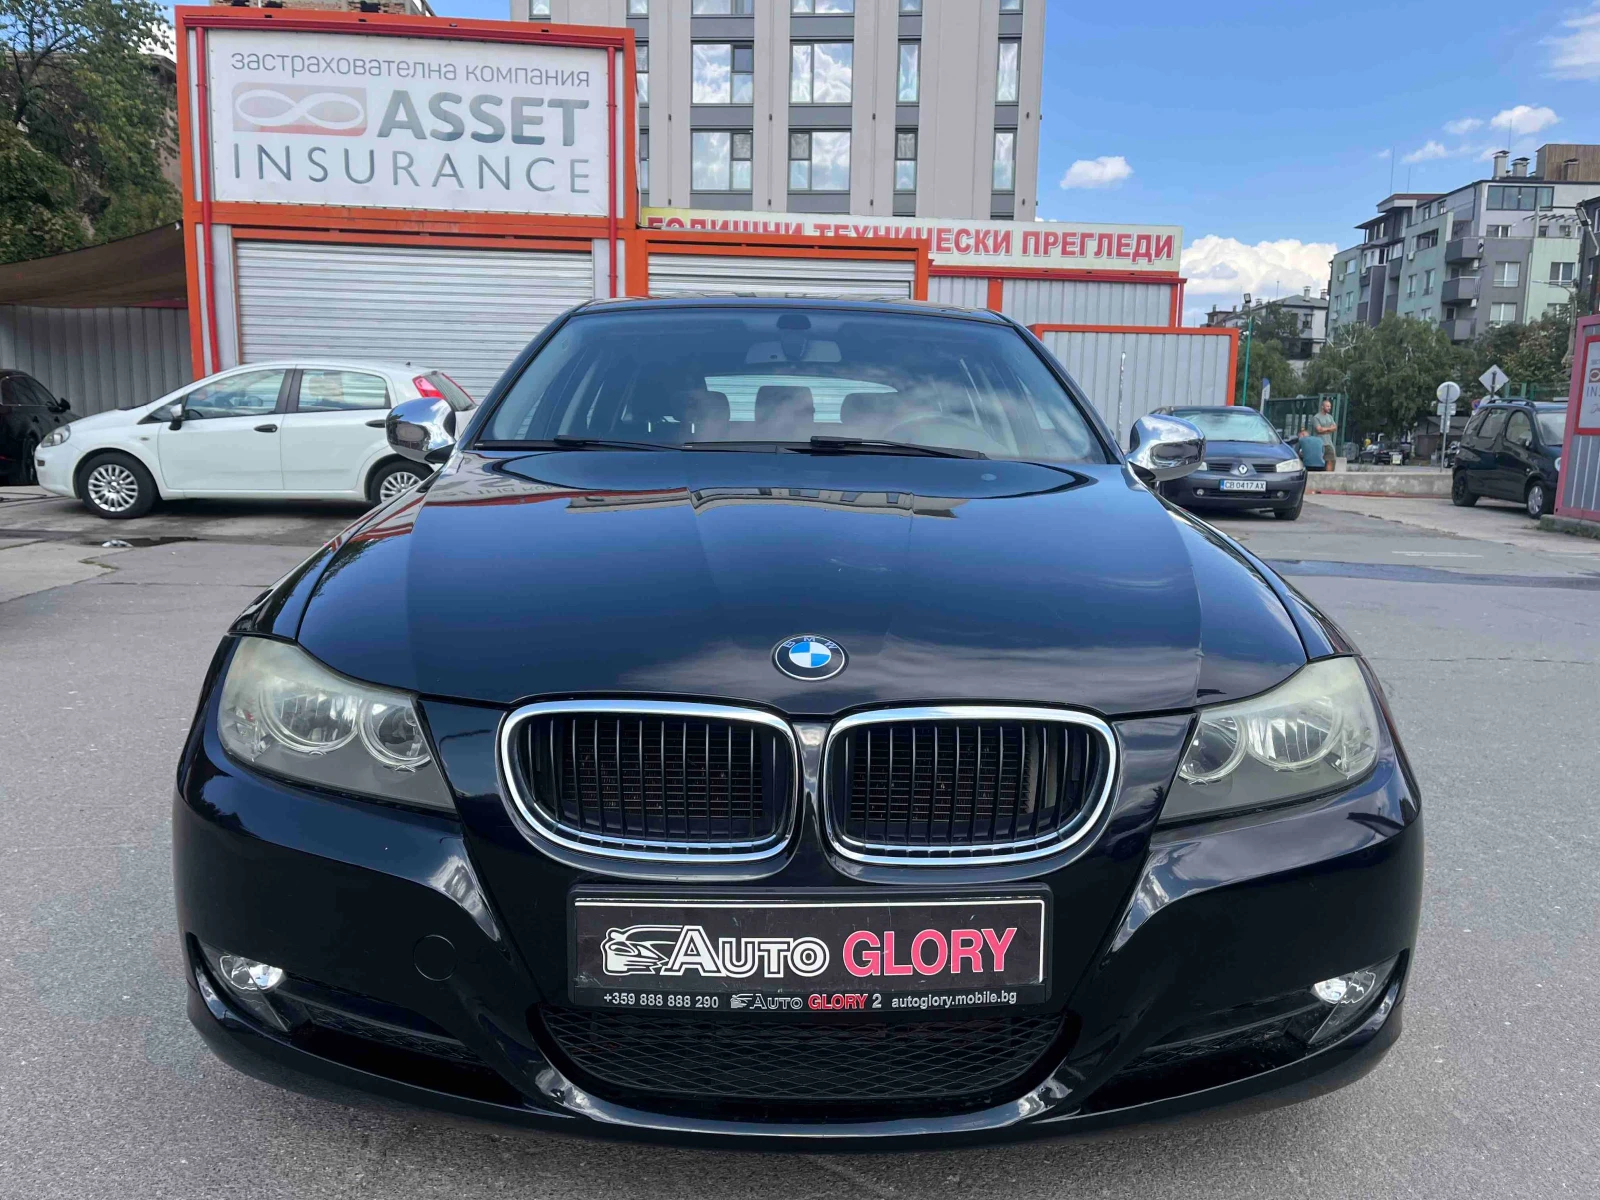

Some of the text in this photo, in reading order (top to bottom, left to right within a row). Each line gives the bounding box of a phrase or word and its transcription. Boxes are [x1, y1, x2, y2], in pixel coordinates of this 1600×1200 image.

[231, 52, 590, 88] застрахователна компания
[377, 90, 590, 147] ASSET
[233, 143, 590, 194] INSURANCE
[1022, 230, 1174, 263] ПРЕГЛЕДИ
[782, 636, 838, 649] BMW
[659, 925, 1017, 979] AUTO GLORY
[604, 990, 1017, 1010] +359 888 888 290 AUTO GLORY 2 autoglory.mobile.bg
